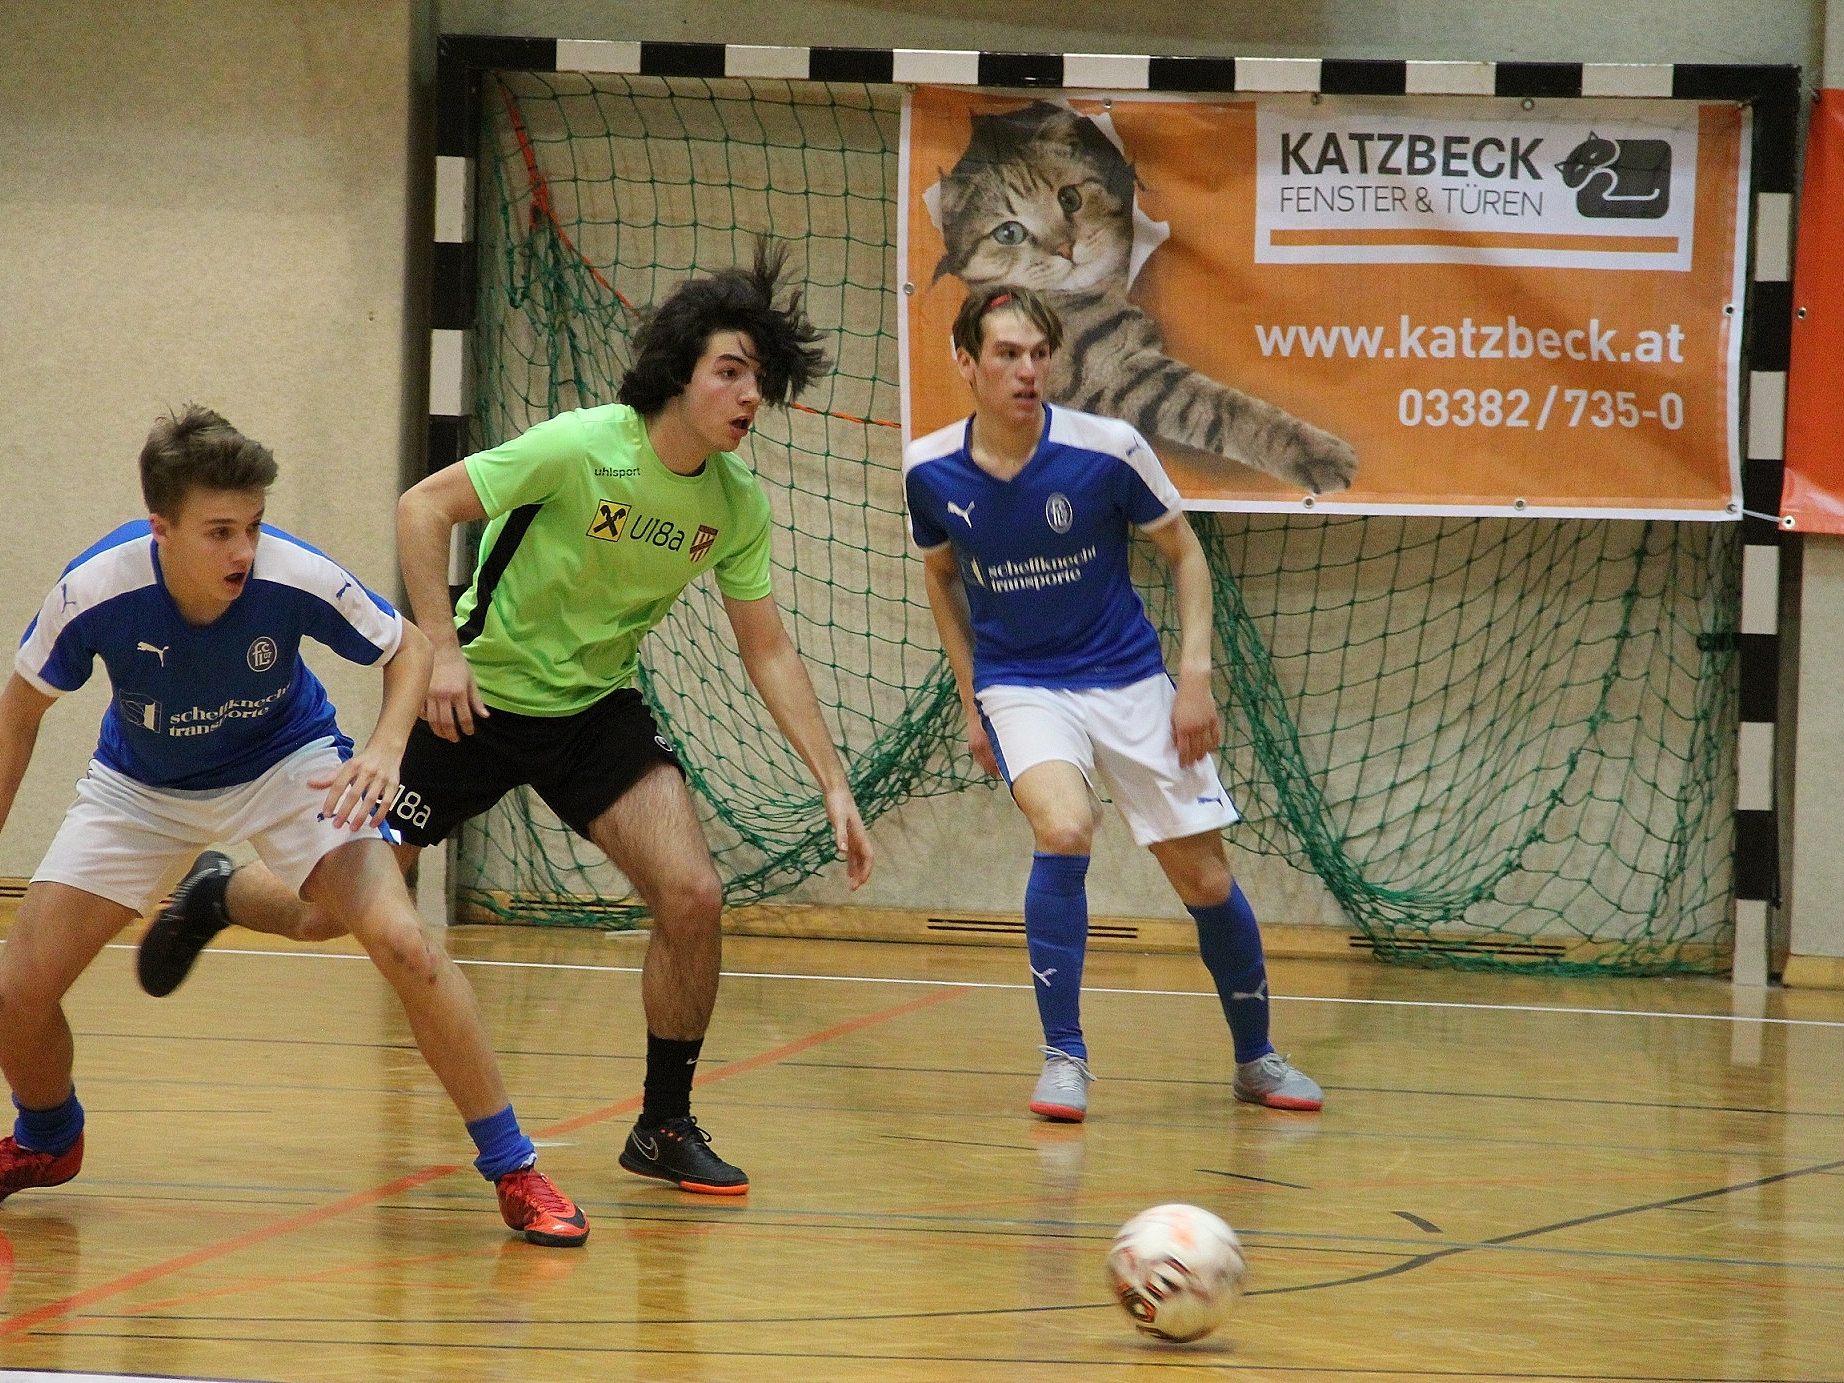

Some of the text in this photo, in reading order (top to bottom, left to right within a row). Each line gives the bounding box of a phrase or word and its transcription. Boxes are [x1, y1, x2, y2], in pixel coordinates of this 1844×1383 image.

[1280, 132, 1544, 180] KATZBECK
[1280, 183, 1543, 217] FENSTER & TÜREN
[1255, 315, 1685, 363] www.katzbeck.at
[594, 467, 641, 478] uhlsport
[630, 514, 685, 552] U18a
[376, 784, 431, 829] 18a
